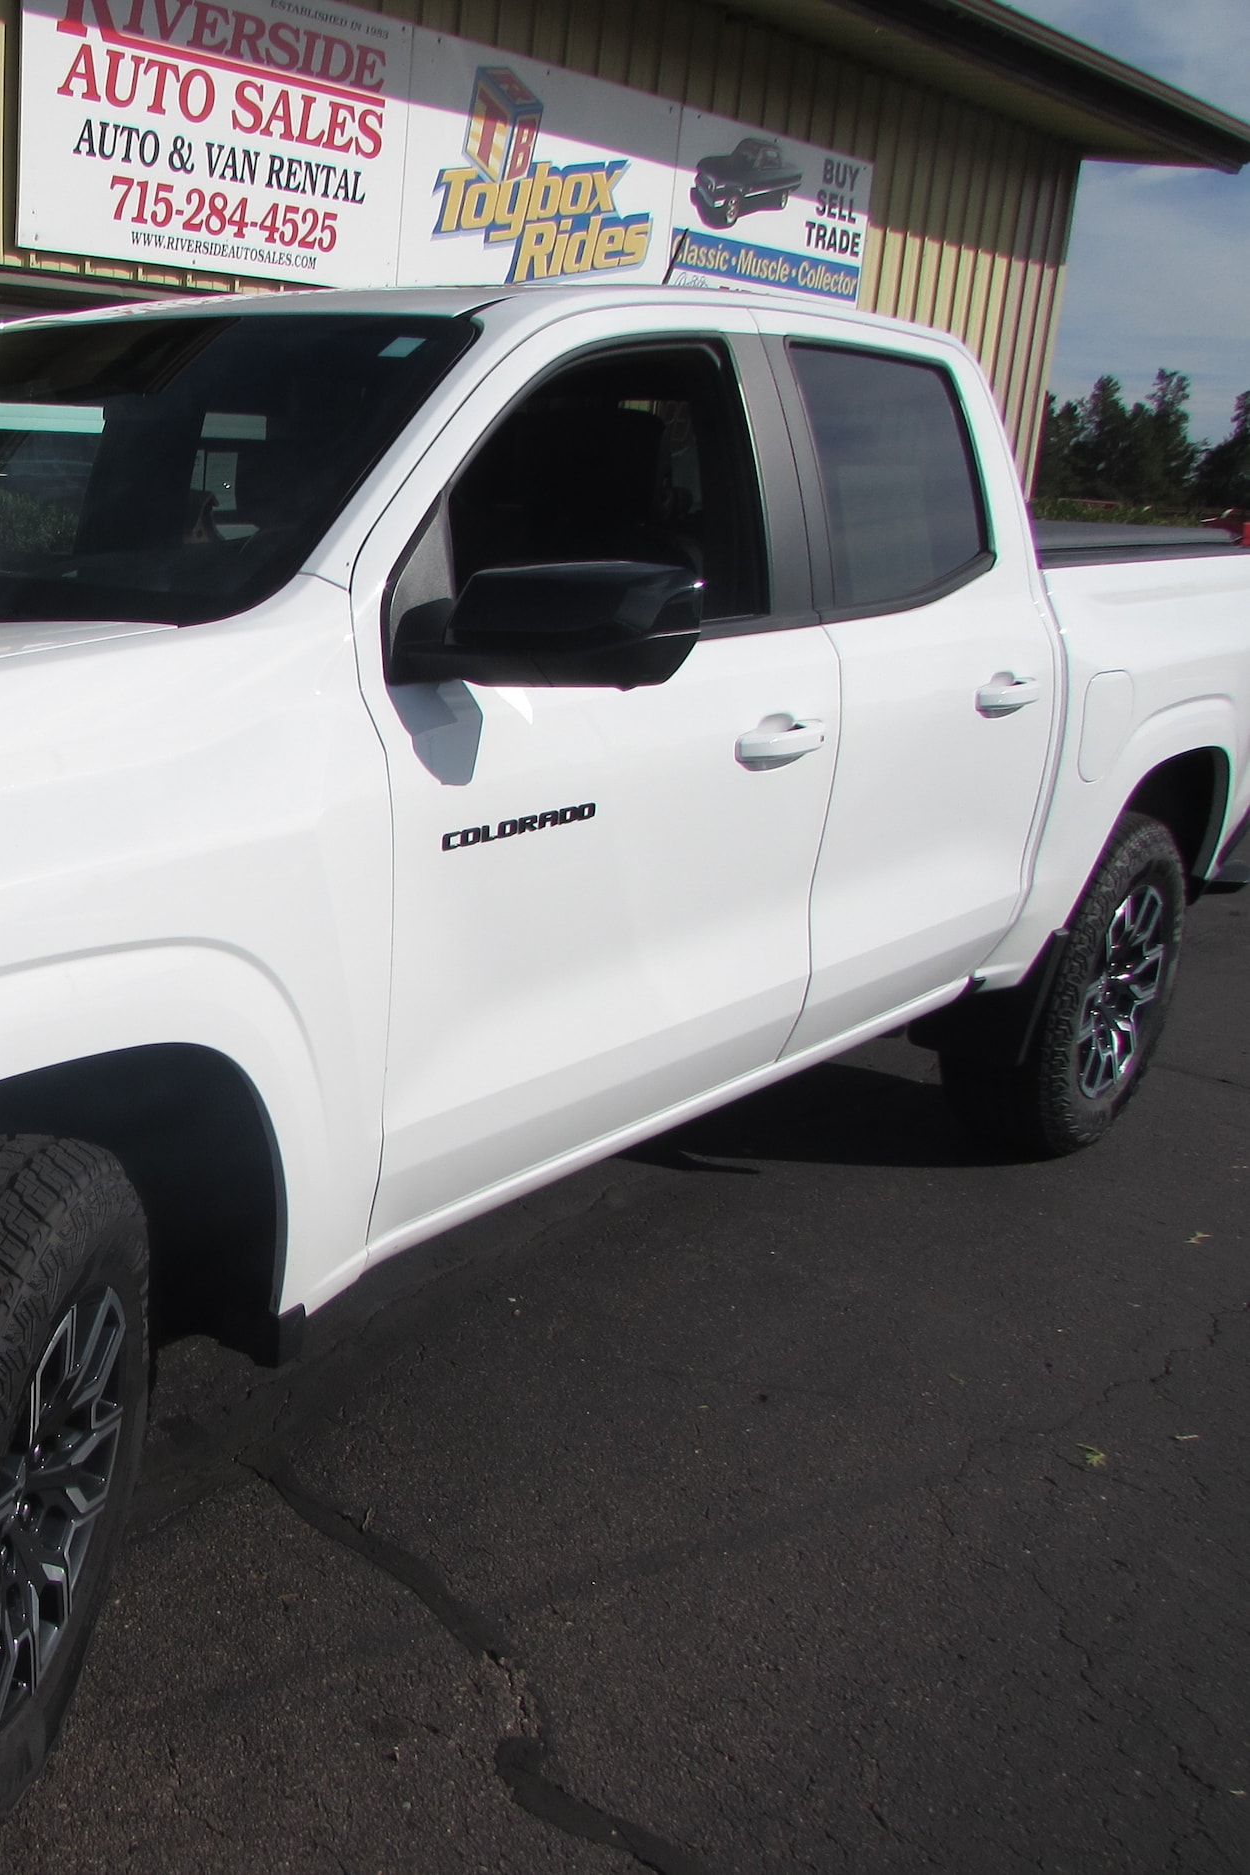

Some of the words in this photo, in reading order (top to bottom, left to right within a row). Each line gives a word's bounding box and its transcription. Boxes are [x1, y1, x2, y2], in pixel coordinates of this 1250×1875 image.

[270, 0, 347, 28] ESTABLISHED
[350, 20, 362, 32] IN
[57, 43, 214, 123] AUTO
[231, 79, 383, 159] SALES
[72, 118, 160, 167] AUTO
[168, 135, 194, 173] &
[205, 142, 260, 185] VAN
[265, 154, 366, 204] RENTAL
[823, 159, 859, 192] BUY
[110, 175, 338, 253] 715-284-4525
[440, 160, 620, 240] Toybox
[815, 192, 856, 223] SELL
[130, 231, 317, 270] WWW.RIVERSIDEAUTOSALES.COM
[514, 220, 650, 283] Rides
[672, 234, 730, 271] Classic
[737, 249, 789, 283] Muscle
[798, 260, 858, 296] Collector
[805, 222, 861, 257] TRADE
[441, 802, 596, 851] COLORADO
